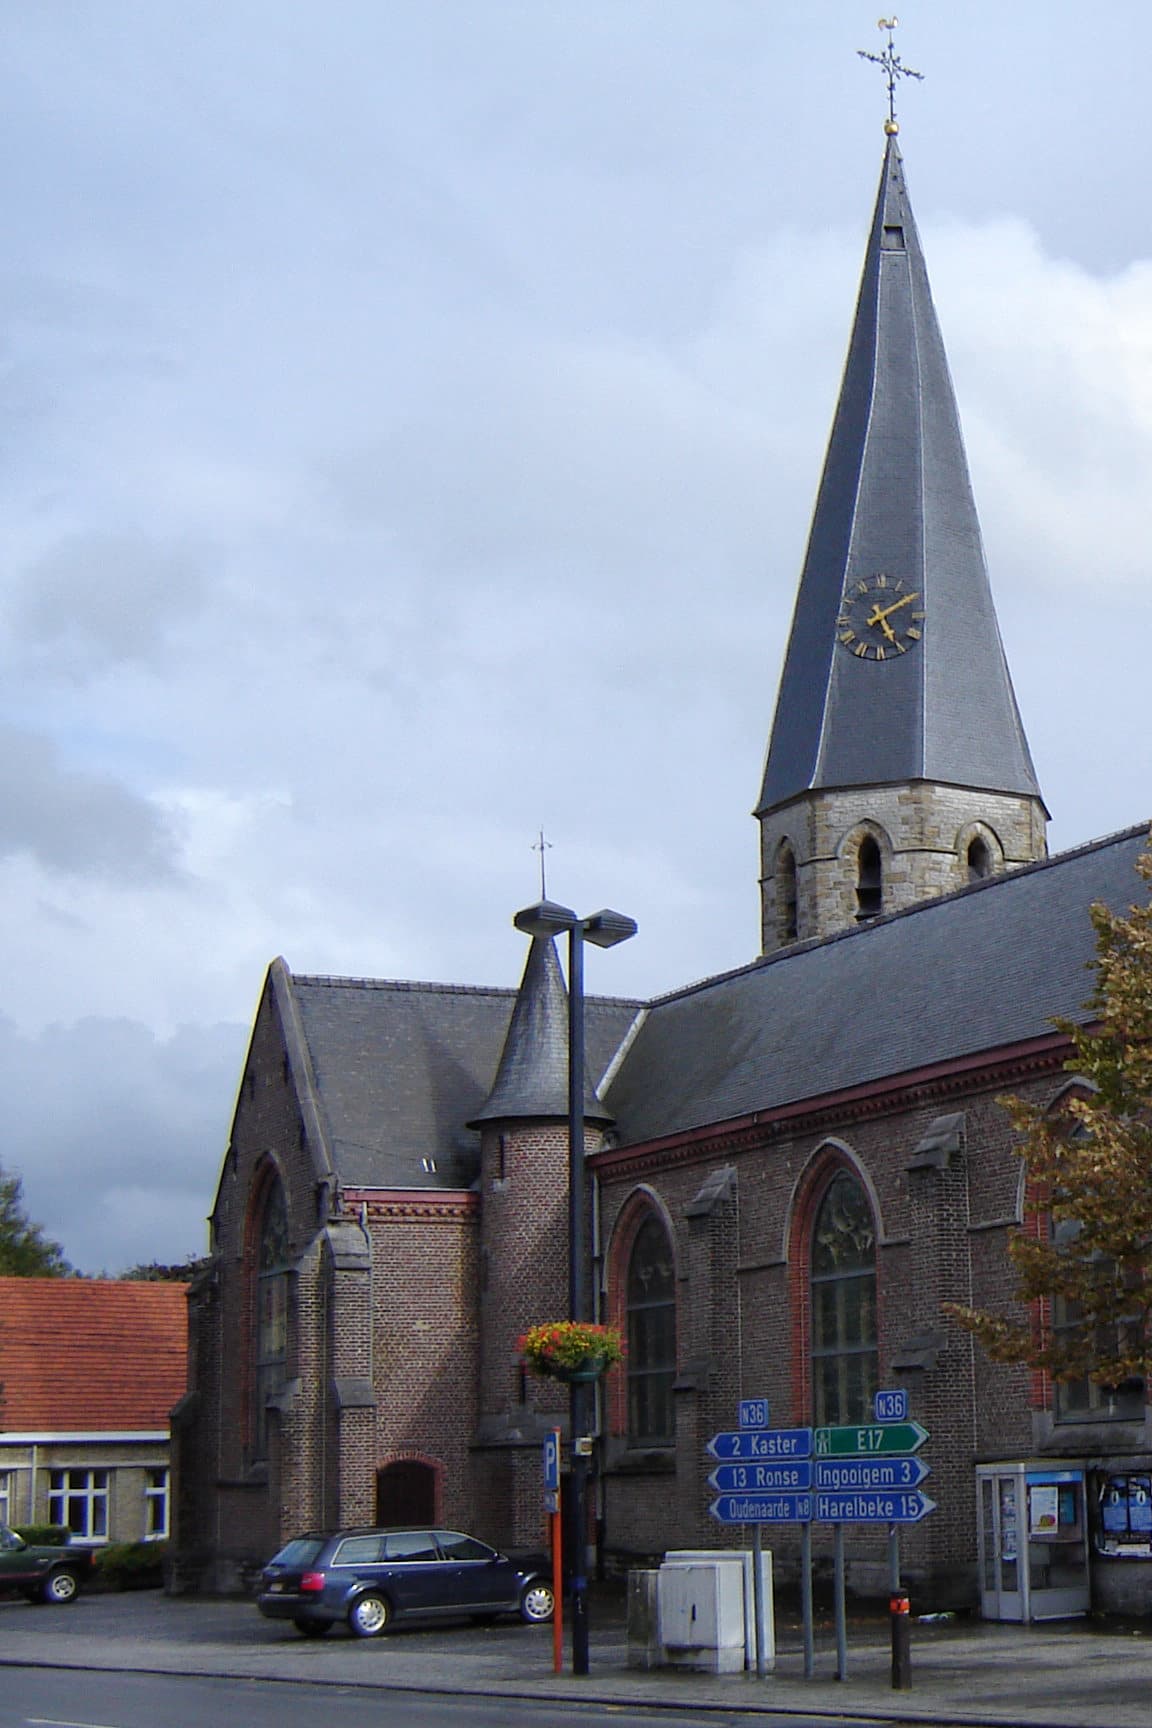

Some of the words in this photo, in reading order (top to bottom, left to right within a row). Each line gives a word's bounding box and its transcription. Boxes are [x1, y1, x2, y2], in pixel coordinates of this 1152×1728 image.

[742, 1406, 764, 1423] N36
[879, 1394, 903, 1417] N36
[732, 1436, 741, 1456] 2
[751, 1435, 797, 1455] Kaster
[857, 1429, 884, 1450] E17
[732, 1467, 747, 1488] 13
[757, 1466, 799, 1486] Ronse
[818, 1464, 894, 1490] Ingooigem
[901, 1462, 911, 1483] 3
[729, 1497, 790, 1518] Oudenaarde
[819, 1497, 894, 1518] Harelbeke
[901, 1495, 918, 1517] 15
